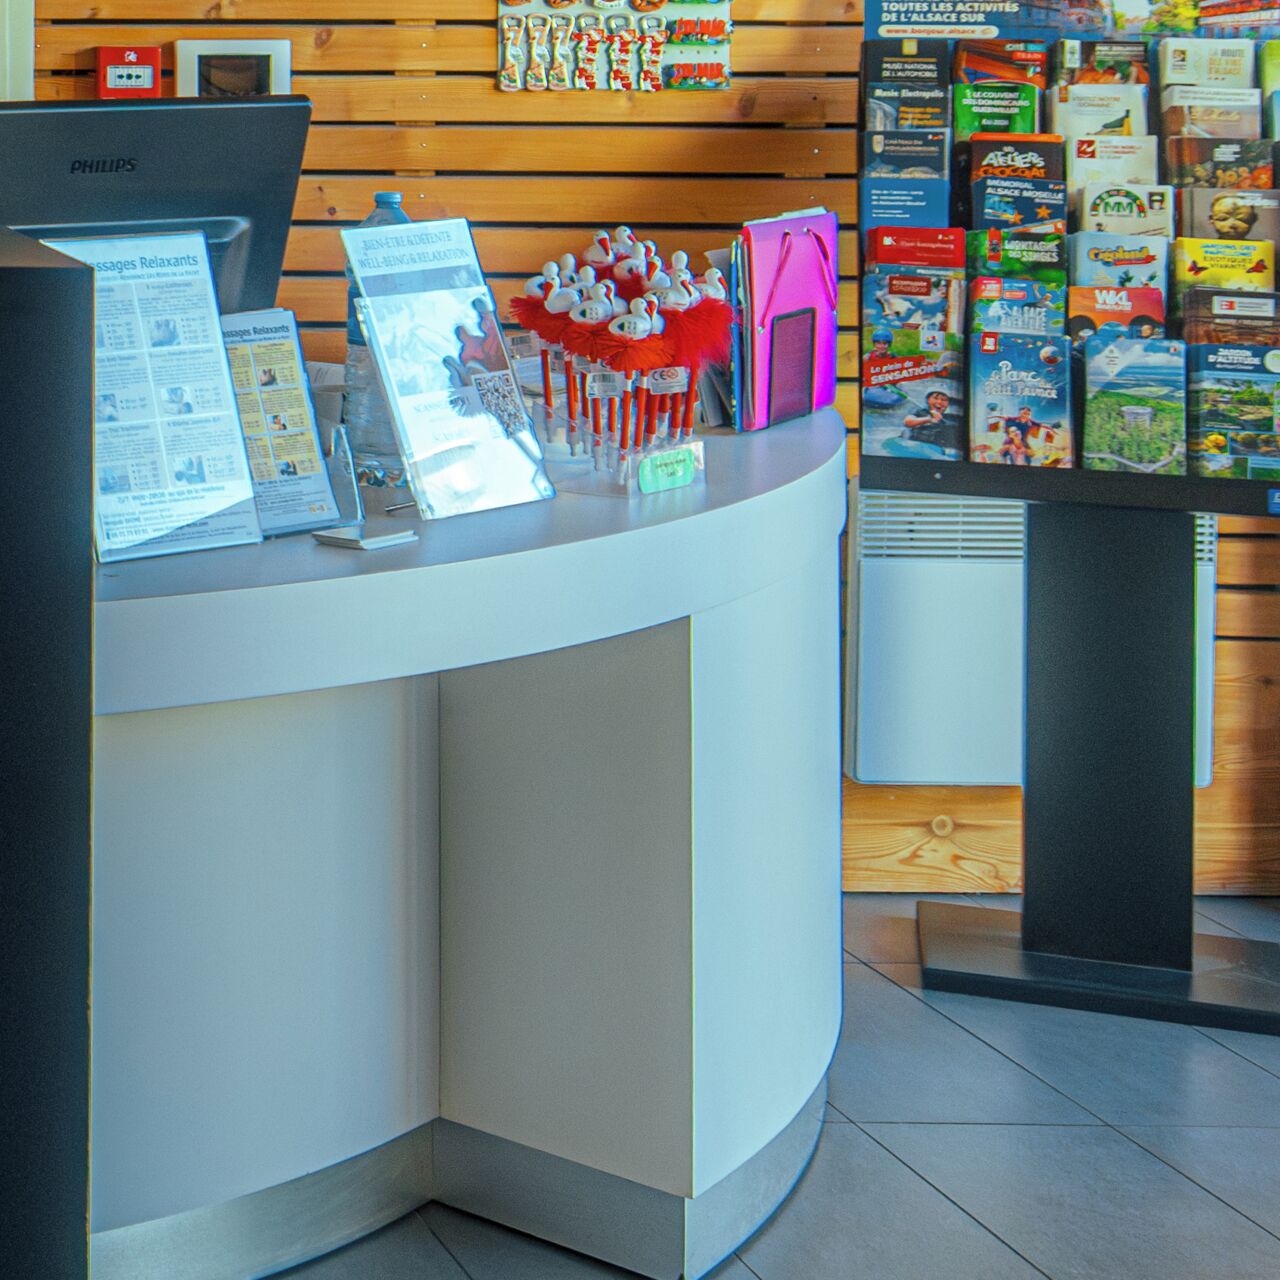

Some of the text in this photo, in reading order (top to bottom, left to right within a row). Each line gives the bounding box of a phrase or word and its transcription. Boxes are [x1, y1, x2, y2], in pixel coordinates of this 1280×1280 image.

[882, 1, 1020, 13] TOUTES LES ACTIVITÉS
[882, 13, 986, 22] DE L'ALSACE SUR
[886, 27, 976, 36] www.bonjour.alsace
[70, 157, 137, 174] PHILIPS
[982, 151, 1046, 168] ATELIERS
[985, 187, 1065, 200] ALSACE MOSELLE
[139, 254, 199, 269] Relaxants
[358, 254, 409, 269] WELL-BEING
[416, 248, 469, 263] RELAXATION
[252, 324, 290, 336] Relaxants
[903, 360, 914, 368] de
[998, 361, 1041, 381] Parc
